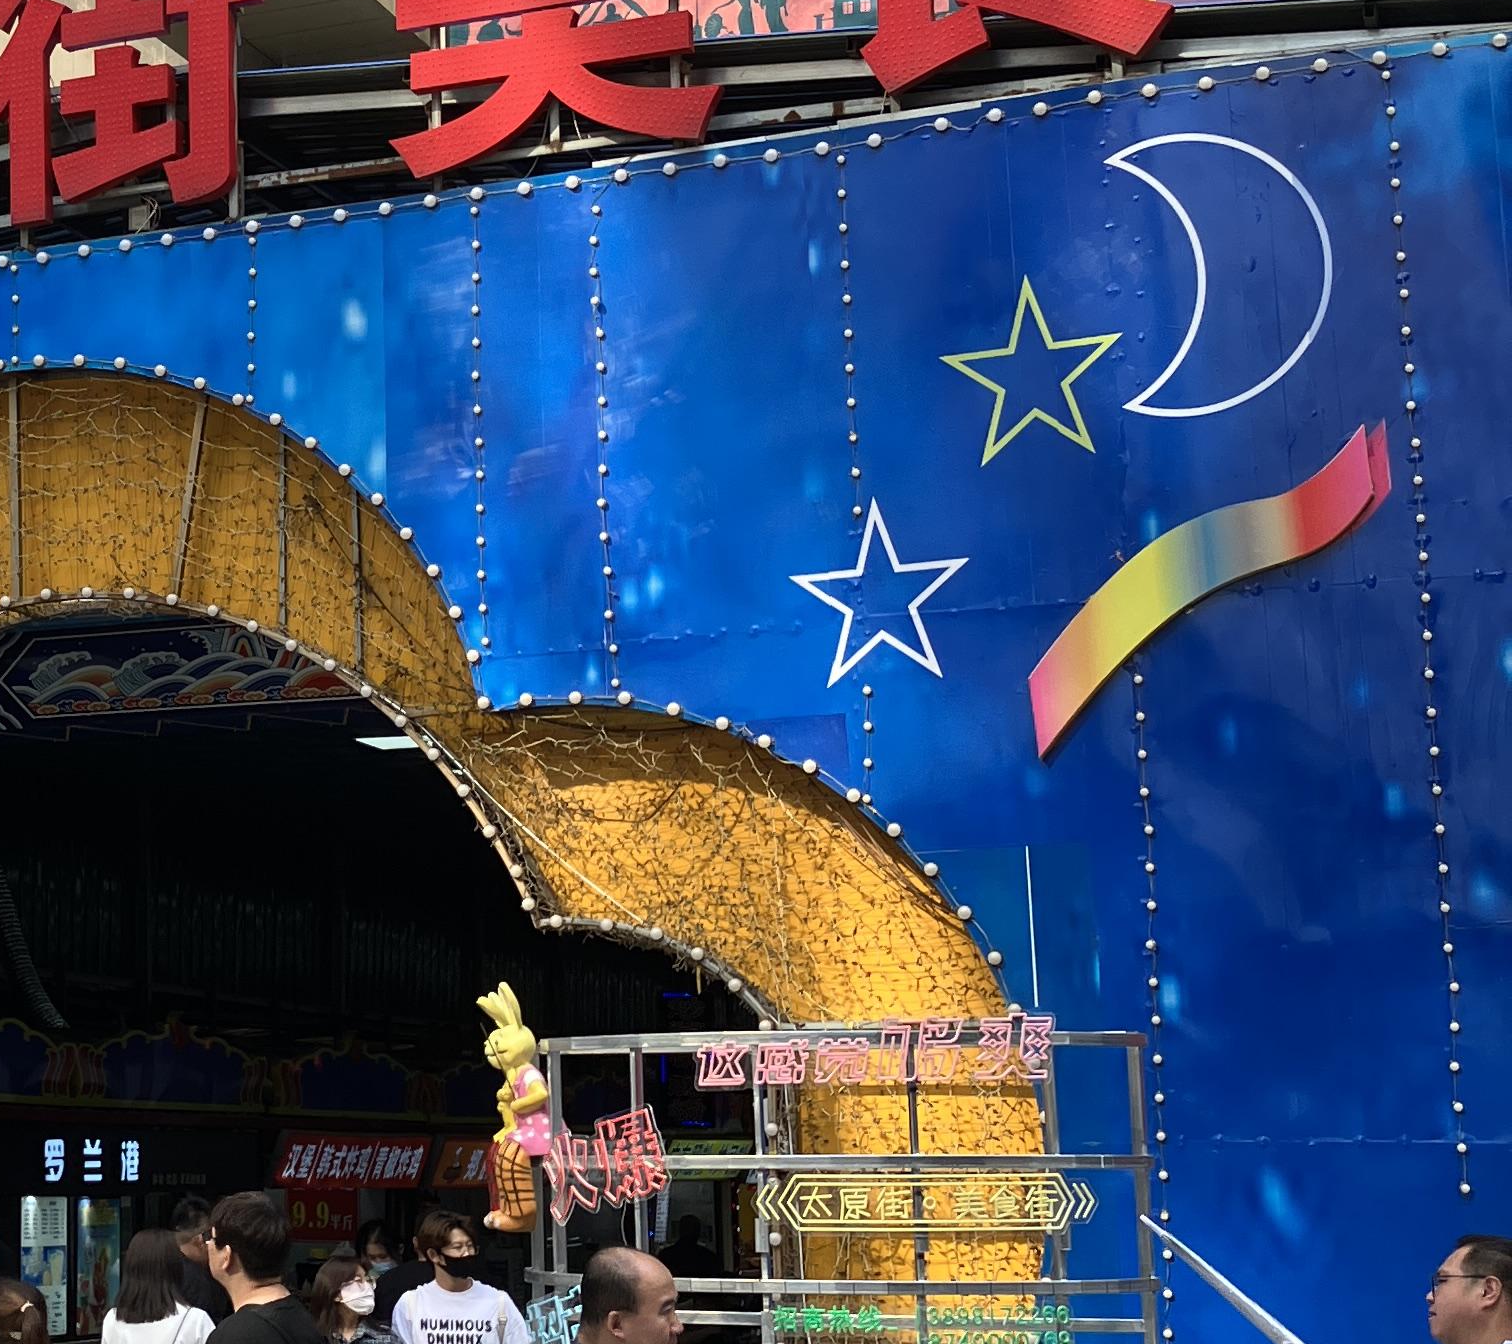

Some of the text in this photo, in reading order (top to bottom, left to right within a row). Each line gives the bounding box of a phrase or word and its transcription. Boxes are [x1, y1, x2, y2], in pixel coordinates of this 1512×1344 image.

[44, 1138, 140, 1183] 罗兰港
[544, 1108, 668, 1222] 火爆
[420, 1318, 492, 1333] NUMINOUS
